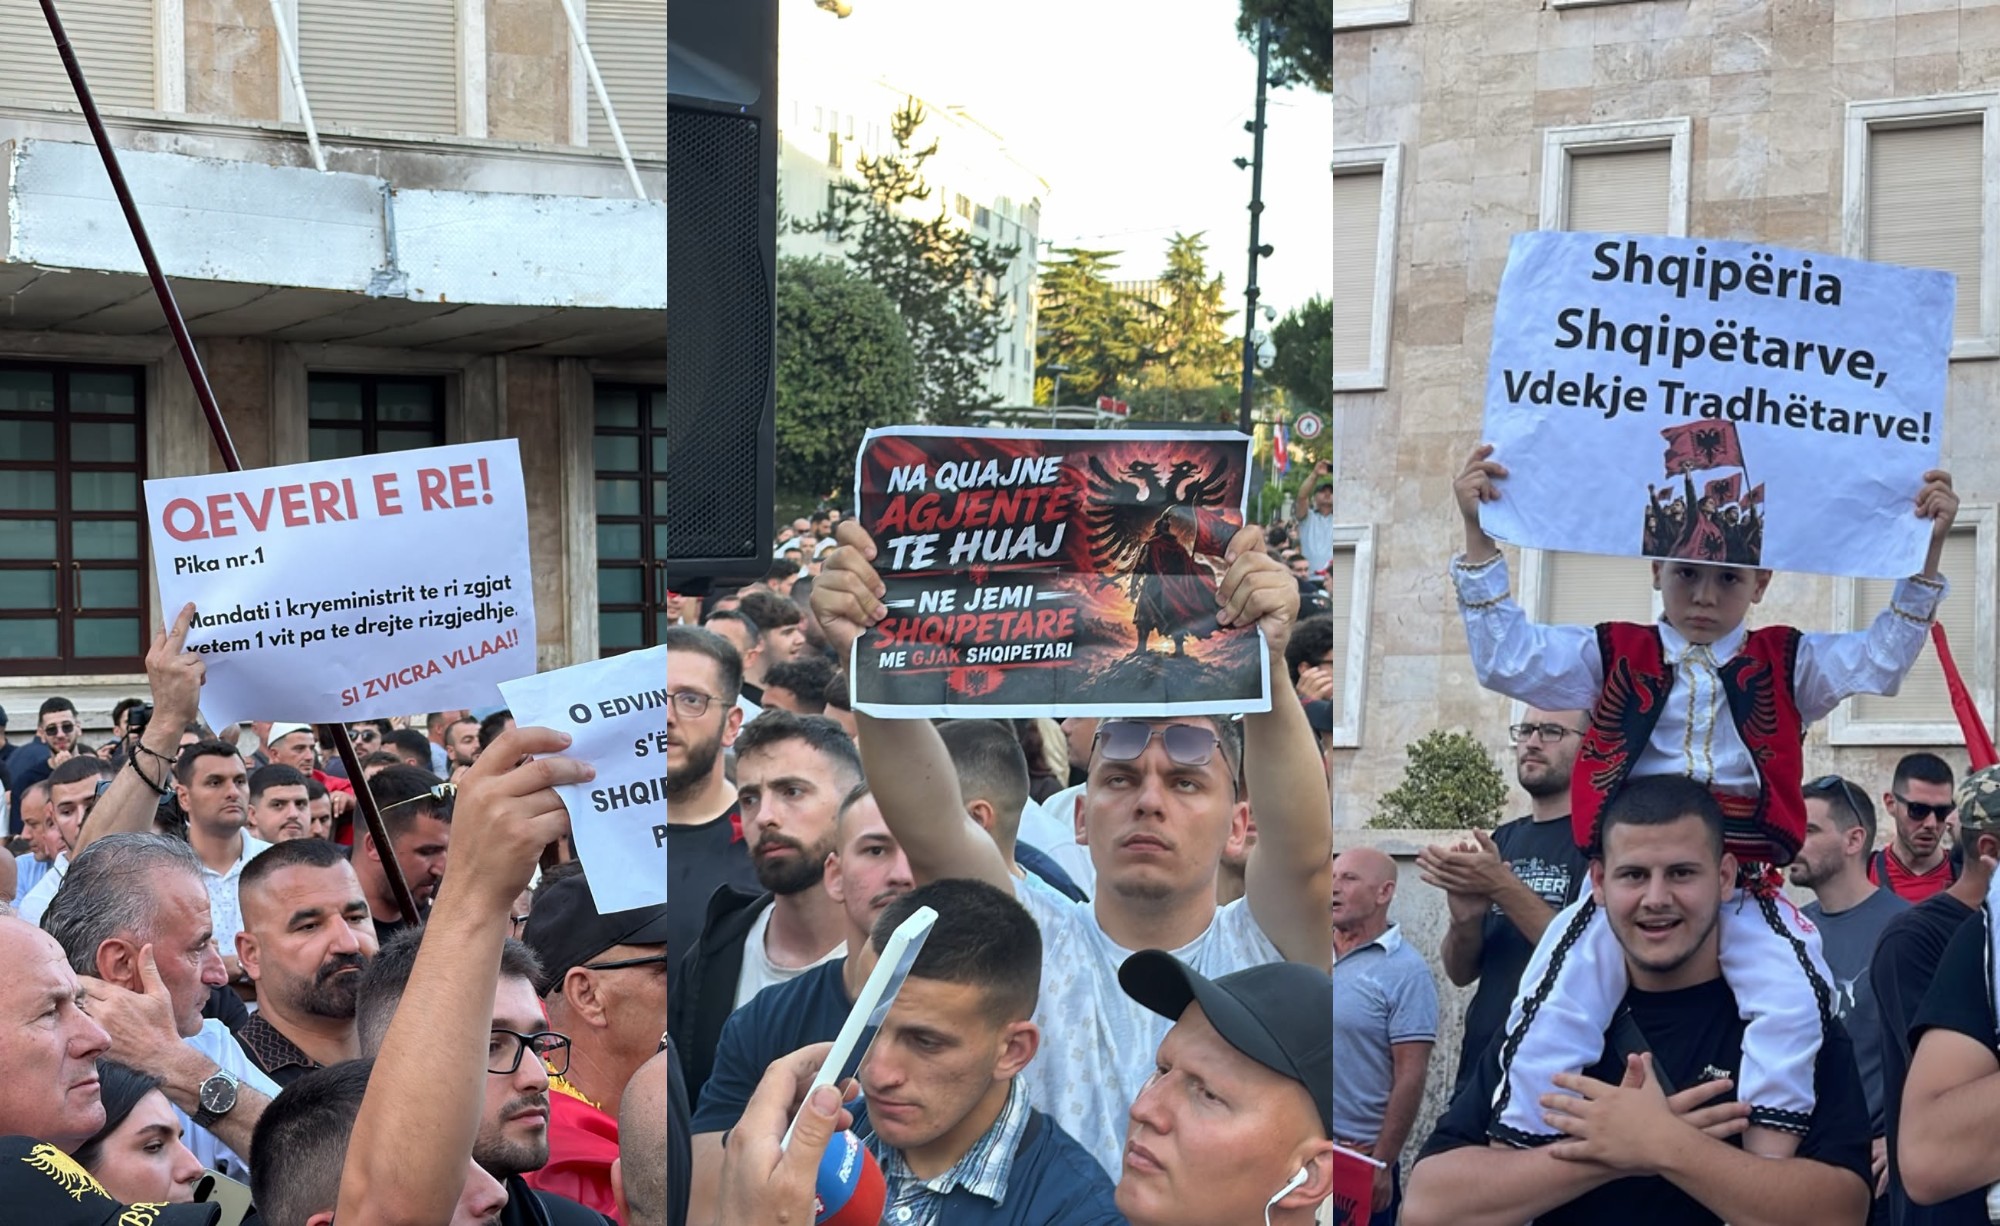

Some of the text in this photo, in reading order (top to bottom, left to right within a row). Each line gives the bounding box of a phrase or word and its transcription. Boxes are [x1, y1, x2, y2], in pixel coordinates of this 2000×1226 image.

[1592, 241, 1841, 306] Shqipëria
[1554, 308, 1888, 389] Shqipëtarve,
[1503, 370, 1932, 445] Vdekje Tradhëtarve!
[887, 455, 1064, 494] NA QUAJNE
[162, 458, 494, 542] QEVERI E RE!
[876, 486, 1076, 534] AGJENTE
[174, 546, 265, 575] Pika nr.1
[887, 522, 1066, 571] TE HUAJ
[188, 575, 512, 629] Mandati i kryeministrit te ri zgjat
[918, 585, 1033, 613] NE JEMI
[187, 600, 518, 654] vetem 1 vit pa te drejte rizgjedhje.
[873, 608, 1078, 649] SHQIPETARE
[341, 628, 519, 707] SI ZVICRA VLLAA!!
[878, 643, 1074, 669] ME GJAK SHQIPETARI
[569, 703, 592, 724] O
